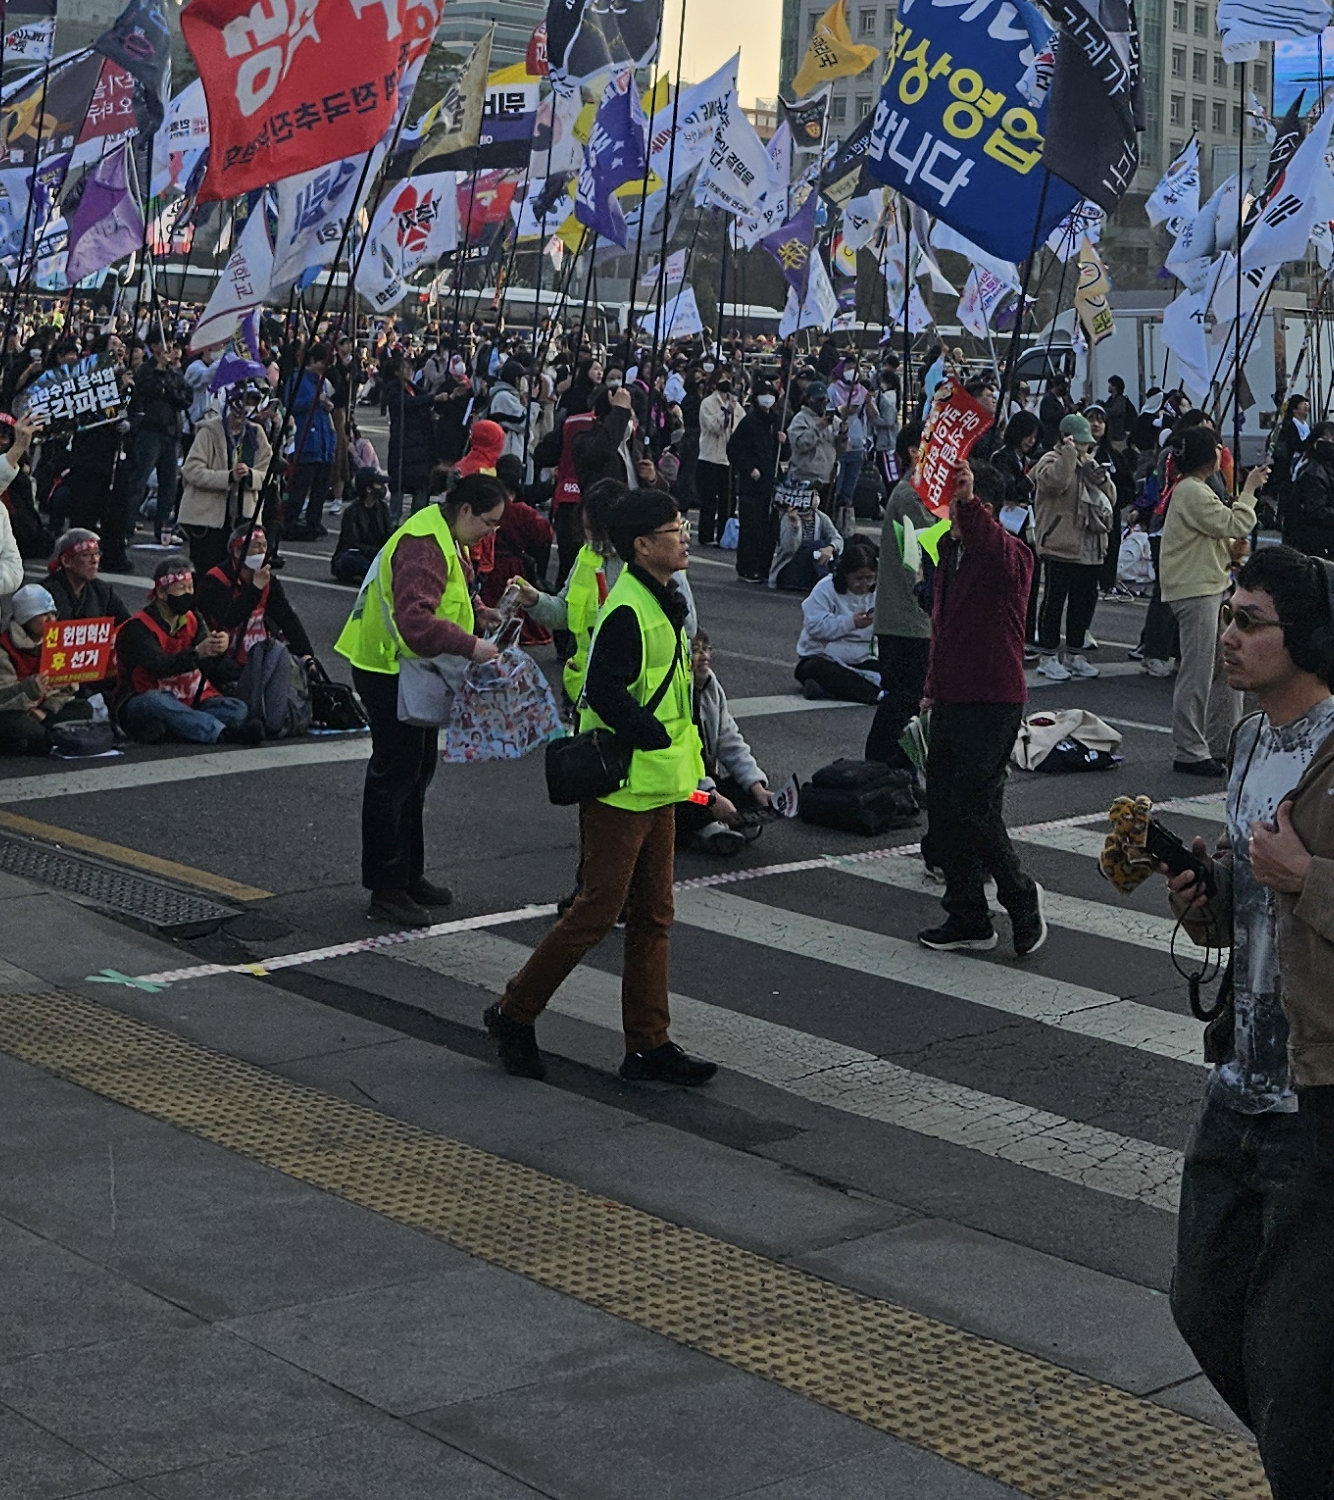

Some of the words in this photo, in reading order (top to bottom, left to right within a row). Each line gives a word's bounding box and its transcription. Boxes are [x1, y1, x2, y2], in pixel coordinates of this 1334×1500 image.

[76, 366, 116, 392] 윤석열
[46, 626, 60, 649] 선
[63, 622, 111, 647] 헌법혁신
[51, 651, 66, 671] 후
[70, 648, 100, 669] 선거
